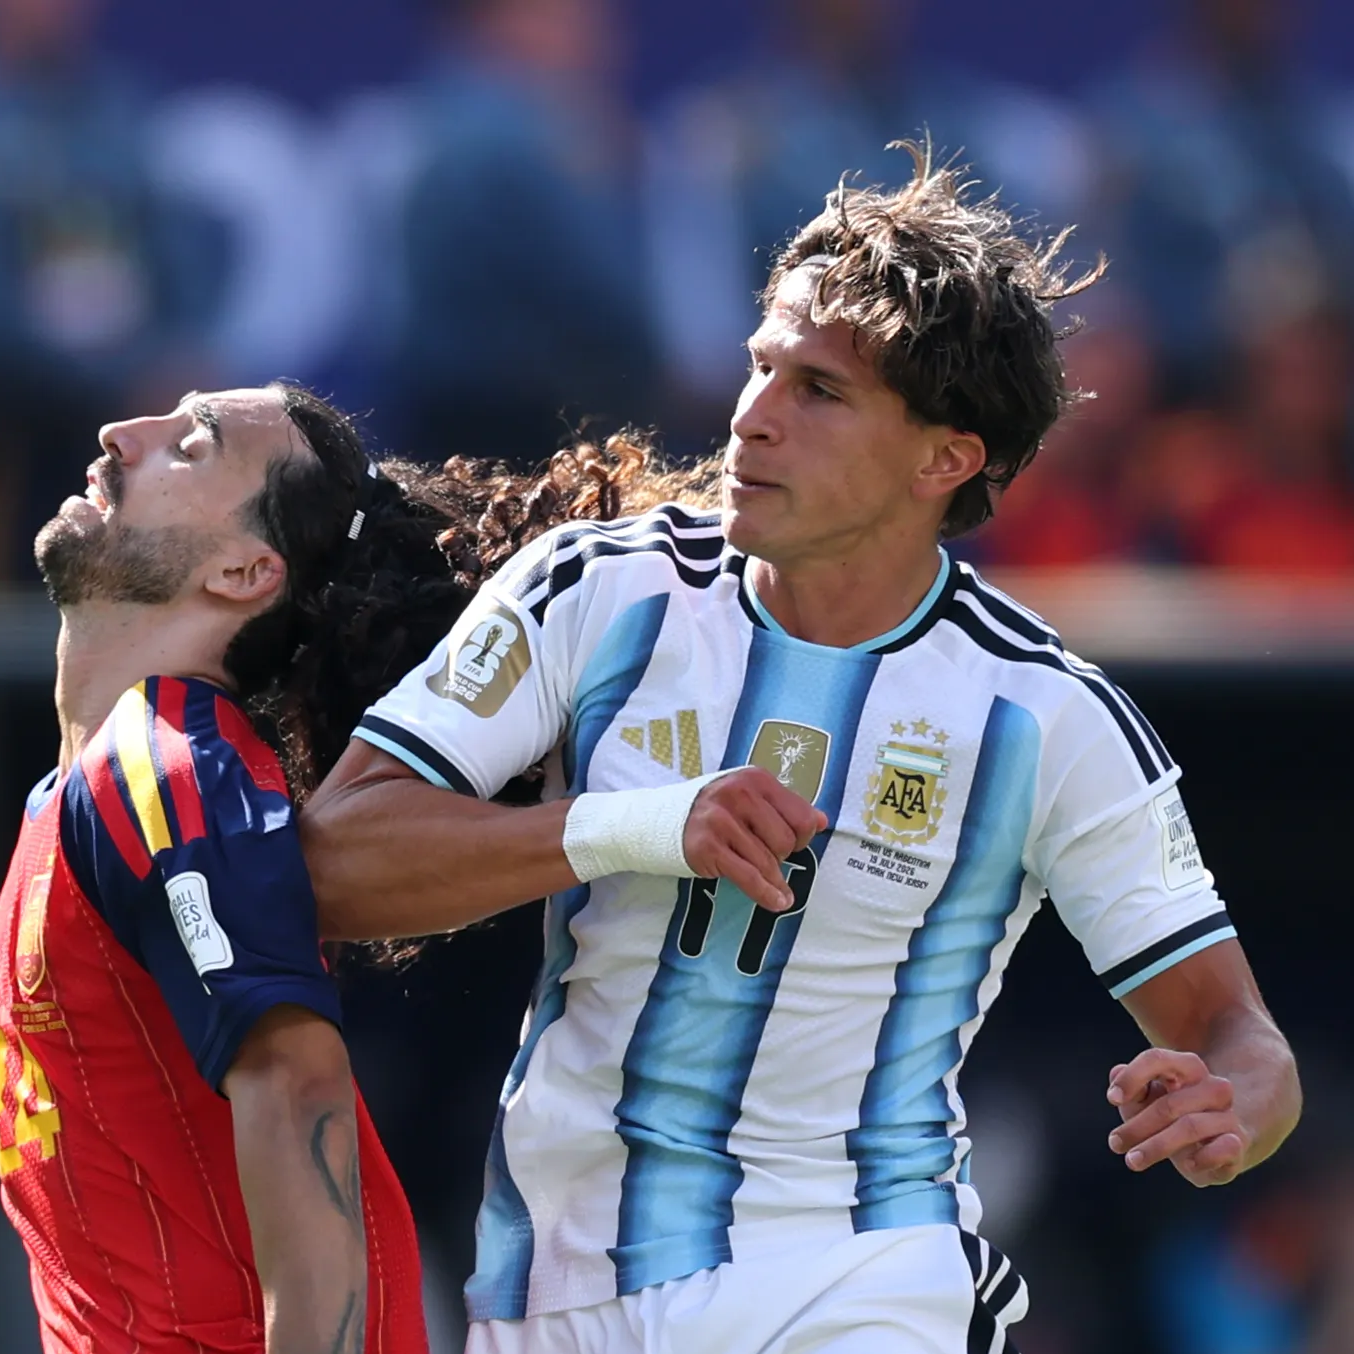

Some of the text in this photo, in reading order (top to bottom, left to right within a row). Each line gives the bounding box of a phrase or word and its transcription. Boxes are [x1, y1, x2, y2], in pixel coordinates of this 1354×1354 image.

[463, 664, 482, 677] FIFA
[880, 768, 927, 819] AFA
[847, 857, 865, 871] NEW
[866, 863, 885, 878] YORK
[880, 856, 896, 870] JULY
[897, 862, 915, 877] 2026
[1182, 858, 1199, 871] FIFA
[171, 889, 196, 910] BALL
